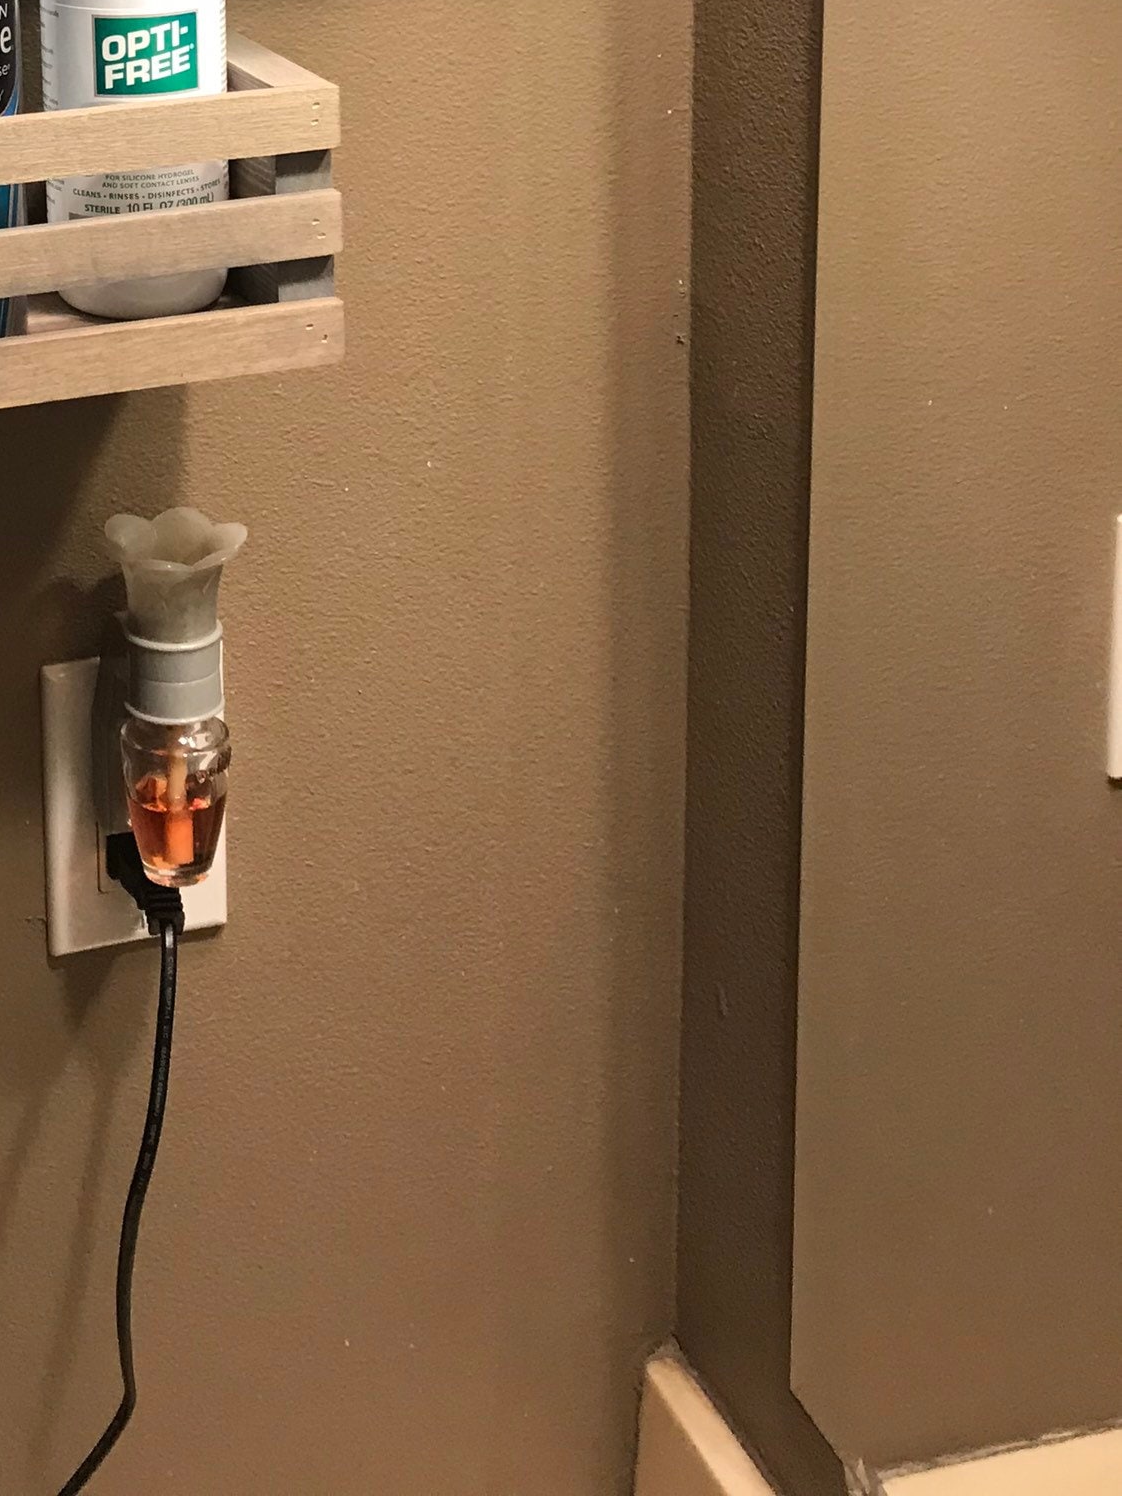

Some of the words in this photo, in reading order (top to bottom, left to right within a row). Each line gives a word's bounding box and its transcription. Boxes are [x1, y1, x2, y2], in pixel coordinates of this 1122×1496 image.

[102, 20, 188, 61] OPTI-
[105, 45, 191, 89] FREE
[157, 169, 195, 179] HYDROGEL
[176, 176, 200, 185] LENSES
[73, 188, 101, 199] CLEANS
[109, 192, 140, 200] RINSES
[148, 186, 195, 199] DISINFECTS
[200, 178, 221, 191] STORES
[84, 203, 121, 214] STERILE
